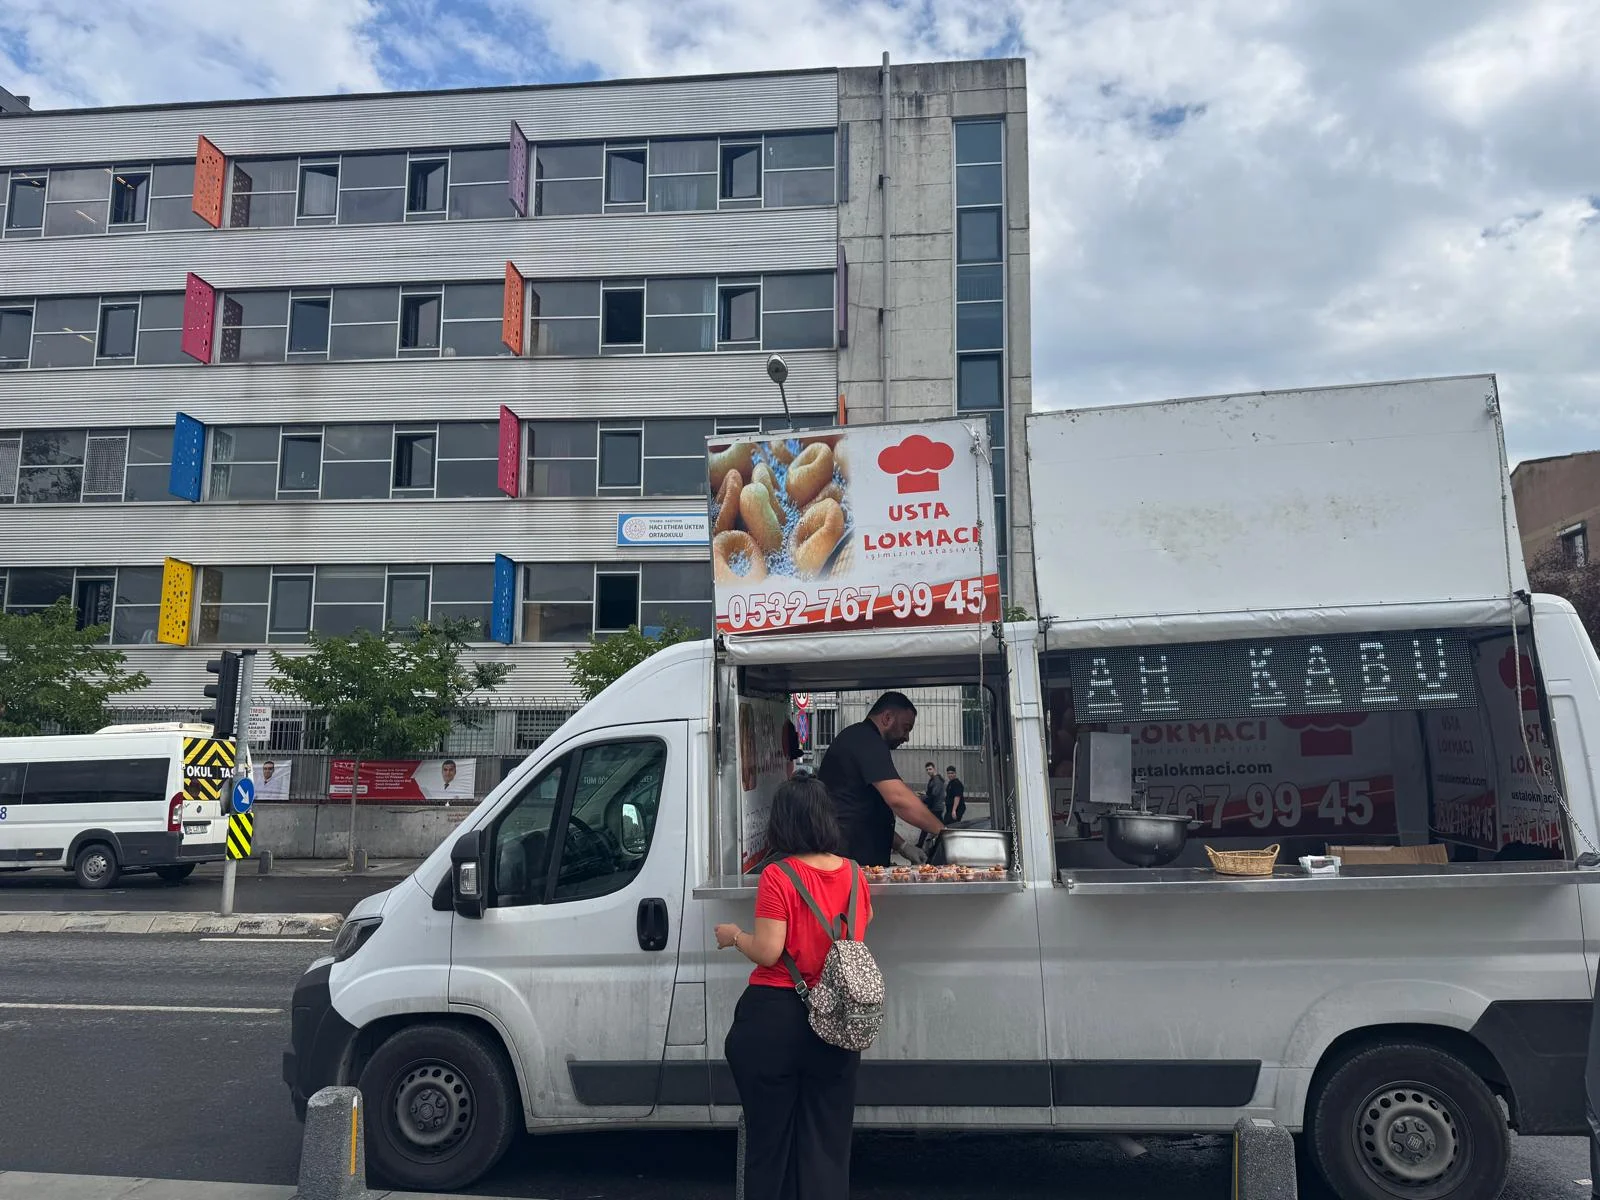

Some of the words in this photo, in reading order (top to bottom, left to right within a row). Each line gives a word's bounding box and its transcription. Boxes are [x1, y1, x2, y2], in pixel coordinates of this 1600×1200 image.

[888, 502, 950, 522] USTA
[648, 523, 663, 531] HACI
[663, 523, 684, 531] ETHEM
[684, 521, 705, 530] ÜKTEM
[863, 526, 981, 551] LOKMACI
[727, 590, 809, 630] 0532
[817, 585, 880, 625] 767
[891, 581, 934, 619] 99
[944, 579, 988, 616] 45
[1087, 654, 1172, 702] AH
[1249, 637, 1450, 700] KABU
[1123, 720, 1268, 745] LOKMACI
[186, 765, 213, 778] OKUL
[1148, 783, 1231, 830] 767
[1246, 781, 1302, 829] 99
[1317, 779, 1375, 826] 45
